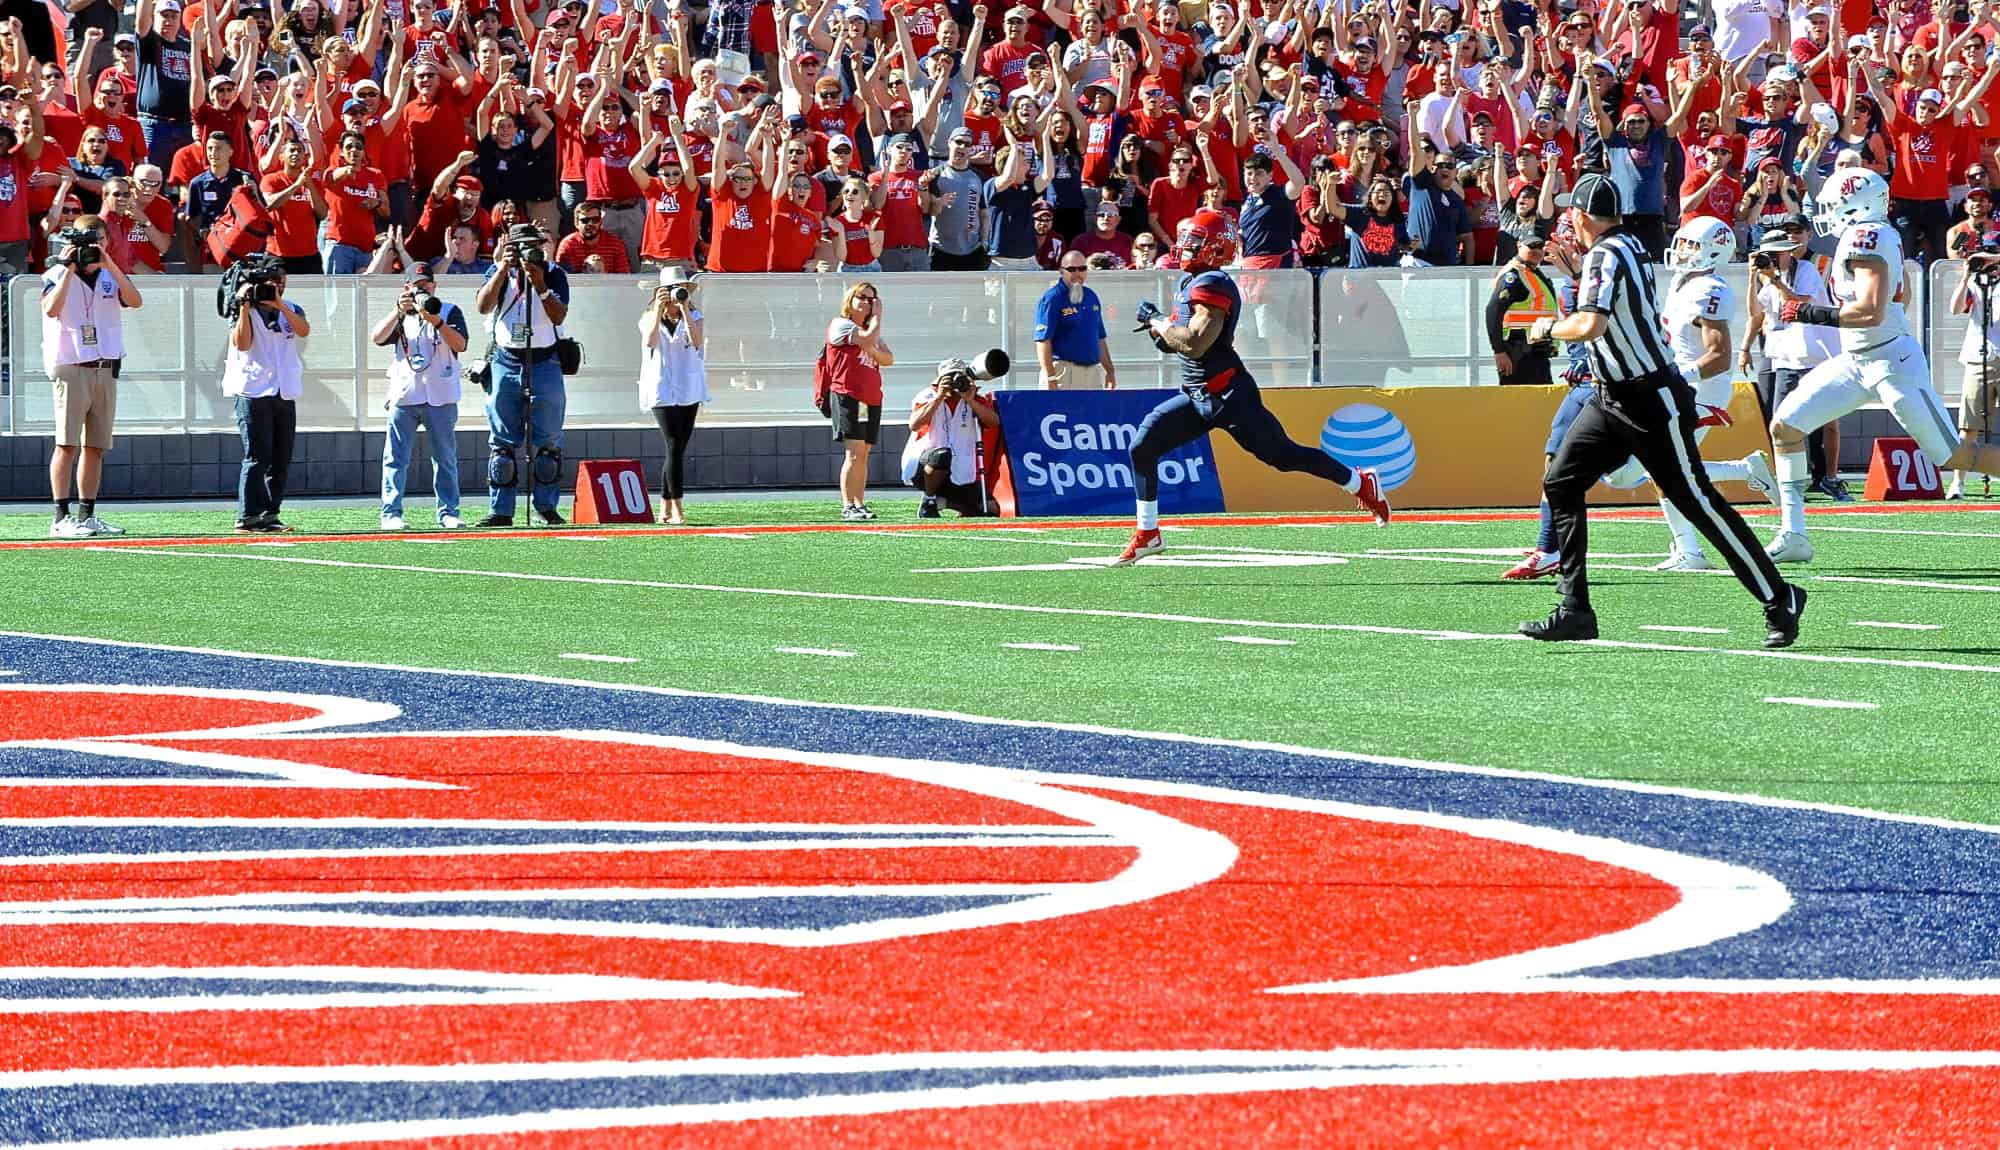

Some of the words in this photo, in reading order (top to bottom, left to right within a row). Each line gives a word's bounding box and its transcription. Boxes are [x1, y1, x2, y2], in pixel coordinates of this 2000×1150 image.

[1706, 295, 1721, 315] 5
[1040, 413, 1138, 450] Gam
[1023, 450, 1205, 495] Sponor
[1890, 448, 1939, 491] 20
[596, 469, 647, 515] 10
